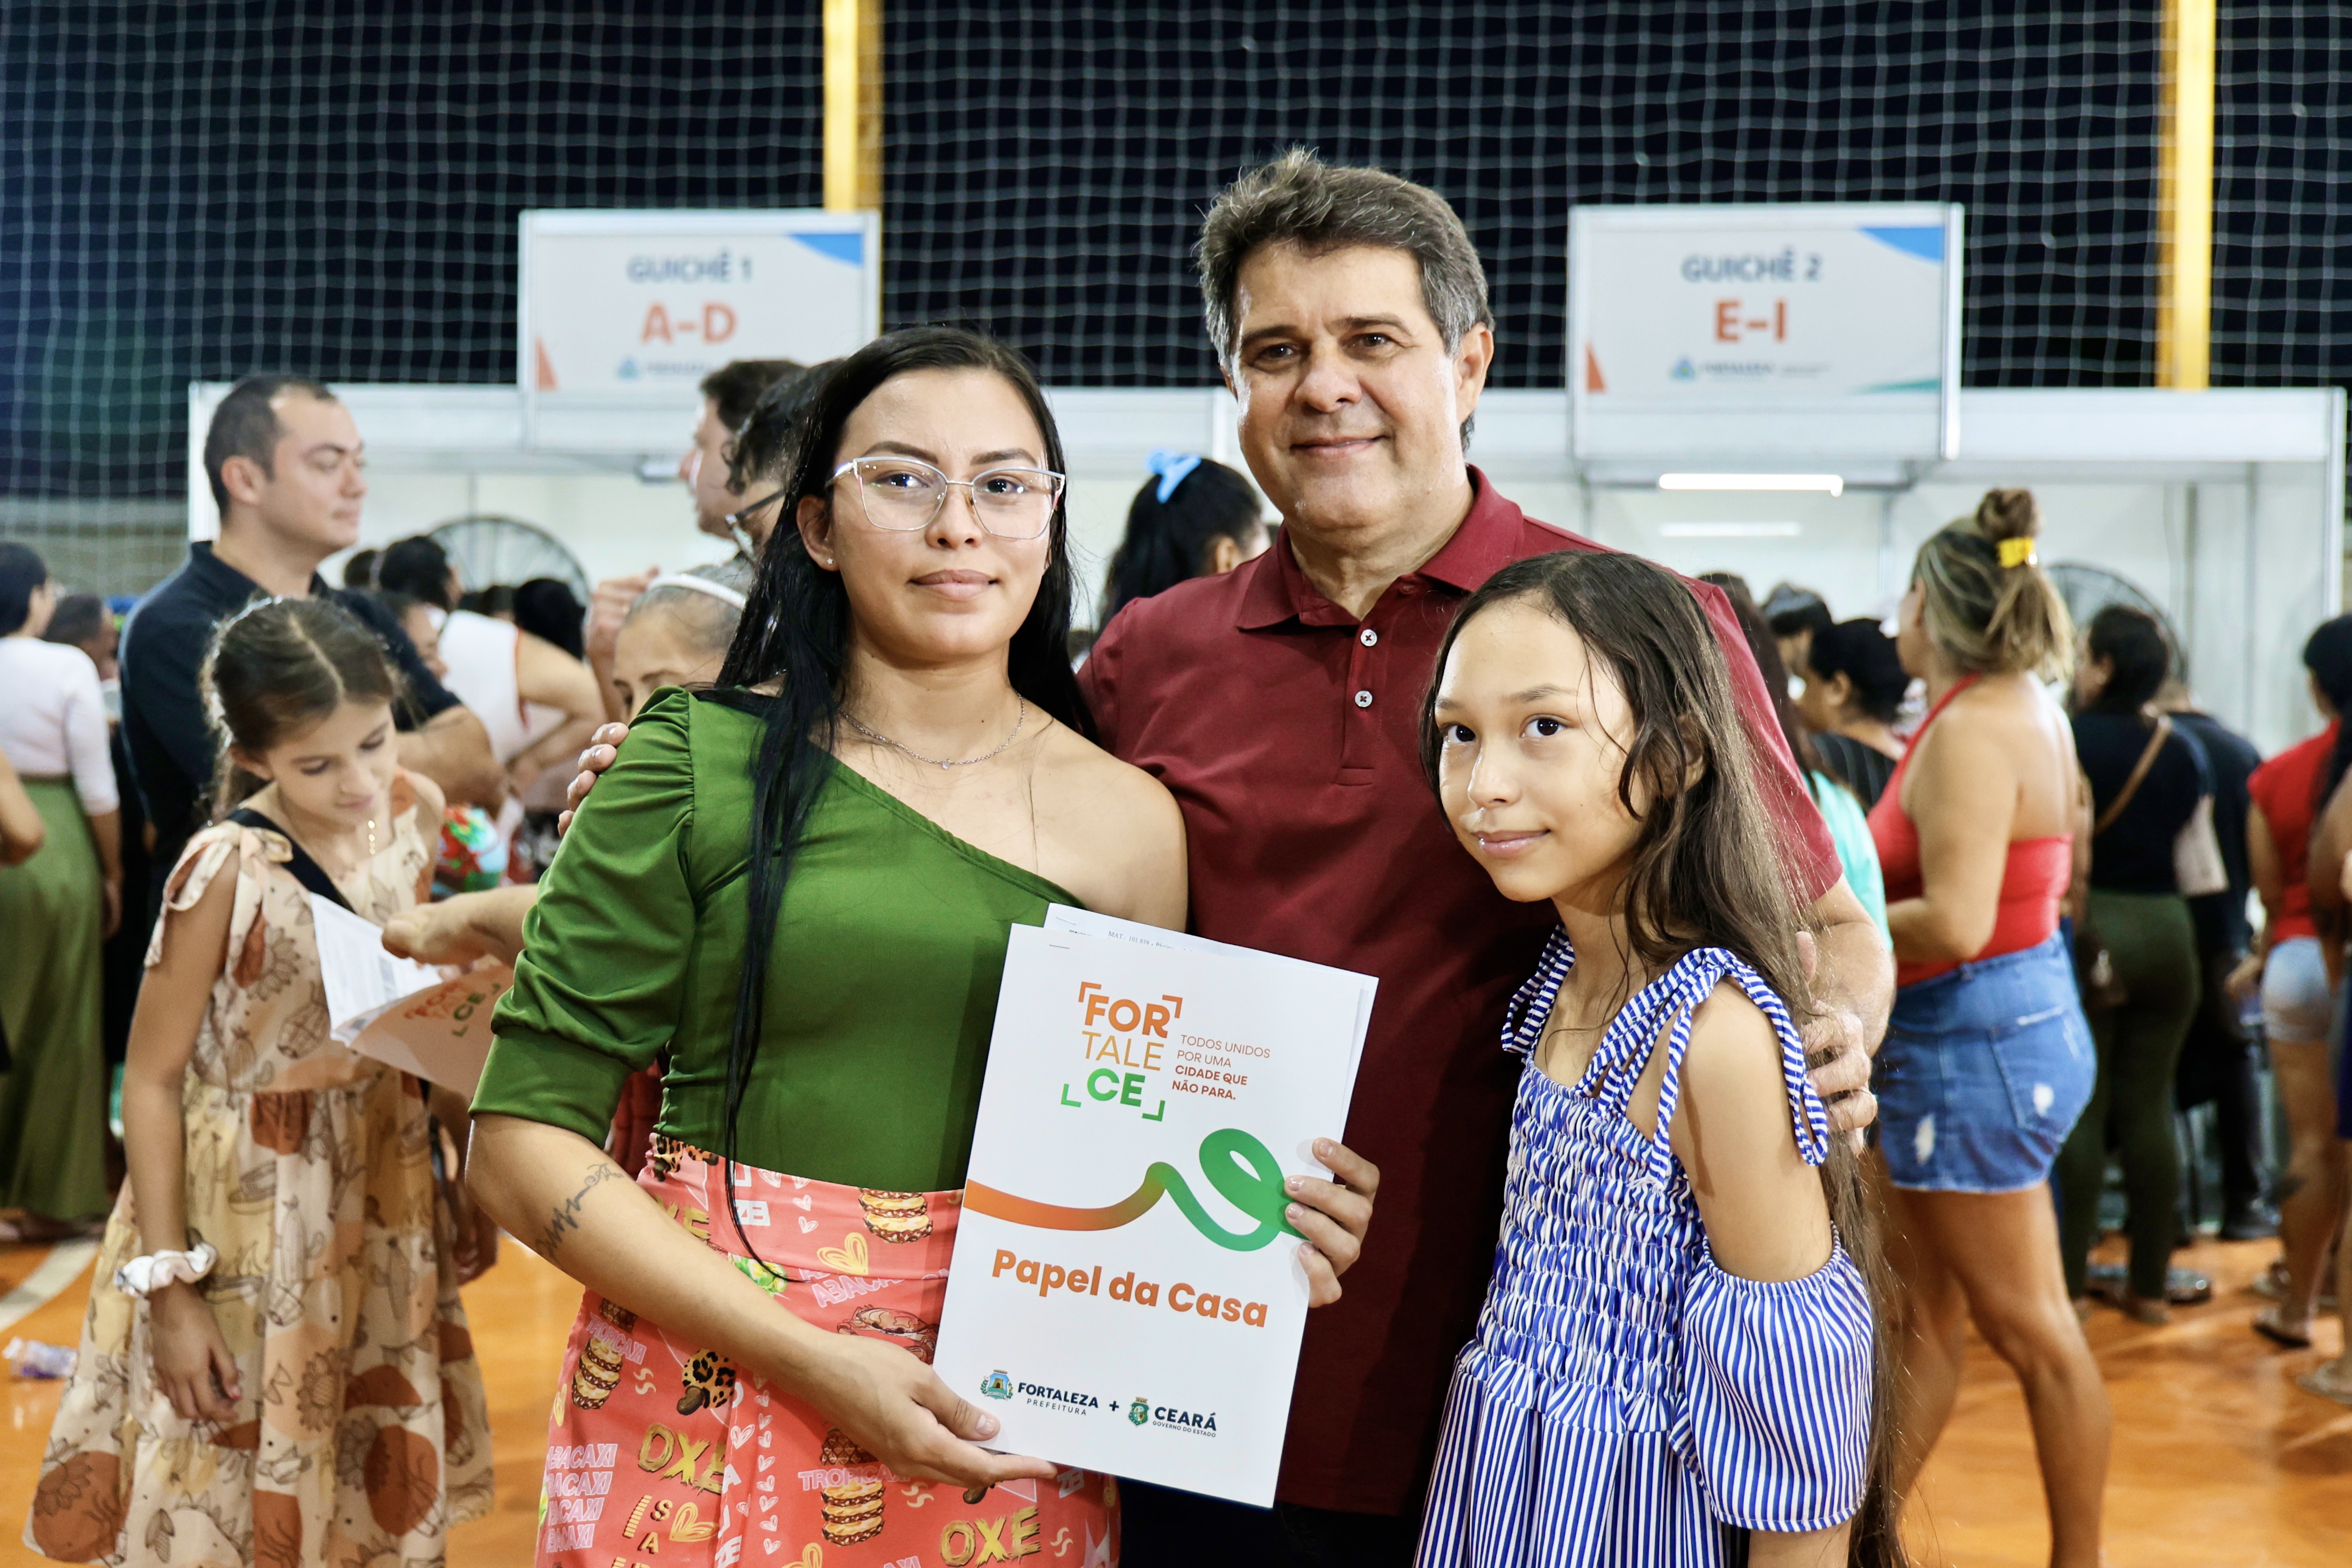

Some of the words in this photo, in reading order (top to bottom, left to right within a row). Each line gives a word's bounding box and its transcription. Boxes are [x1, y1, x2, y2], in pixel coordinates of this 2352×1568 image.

[627, 249, 728, 283] GUICHÊ
[741, 258, 752, 280] 1
[1681, 247, 1795, 284] GUICHÊ
[1805, 255, 1823, 282] 2
[1129, 936, 1150, 946] 101.939
[1084, 994, 1171, 1038] FOR
[1082, 1031, 1165, 1071] TALE
[1177, 1050, 1202, 1063] POR
[1205, 1054, 1231, 1068] UMA
[1181, 1035, 1222, 1050] TODOS
[1225, 1042, 1270, 1058] UNIDOS
[1087, 1067, 1146, 1107] CE
[1175, 1065, 1221, 1081] CIDADE
[1223, 1073, 1248, 1086] QUE
[1172, 1080, 1198, 1093] NÃO
[1201, 1085, 1235, 1100] PARA.
[992, 1249, 1102, 1297] Papel
[1108, 1272, 1159, 1307] da
[1168, 1283, 1268, 1328] Casa
[1018, 1382, 1099, 1408] FORTALEZA
[1155, 1406, 1216, 1431] CEARÁ
[1027, 1398, 1087, 1416] PREFEITURA
[1153, 1421, 1181, 1431] GOVERNO
[1193, 1429, 1216, 1438] ESTADO
